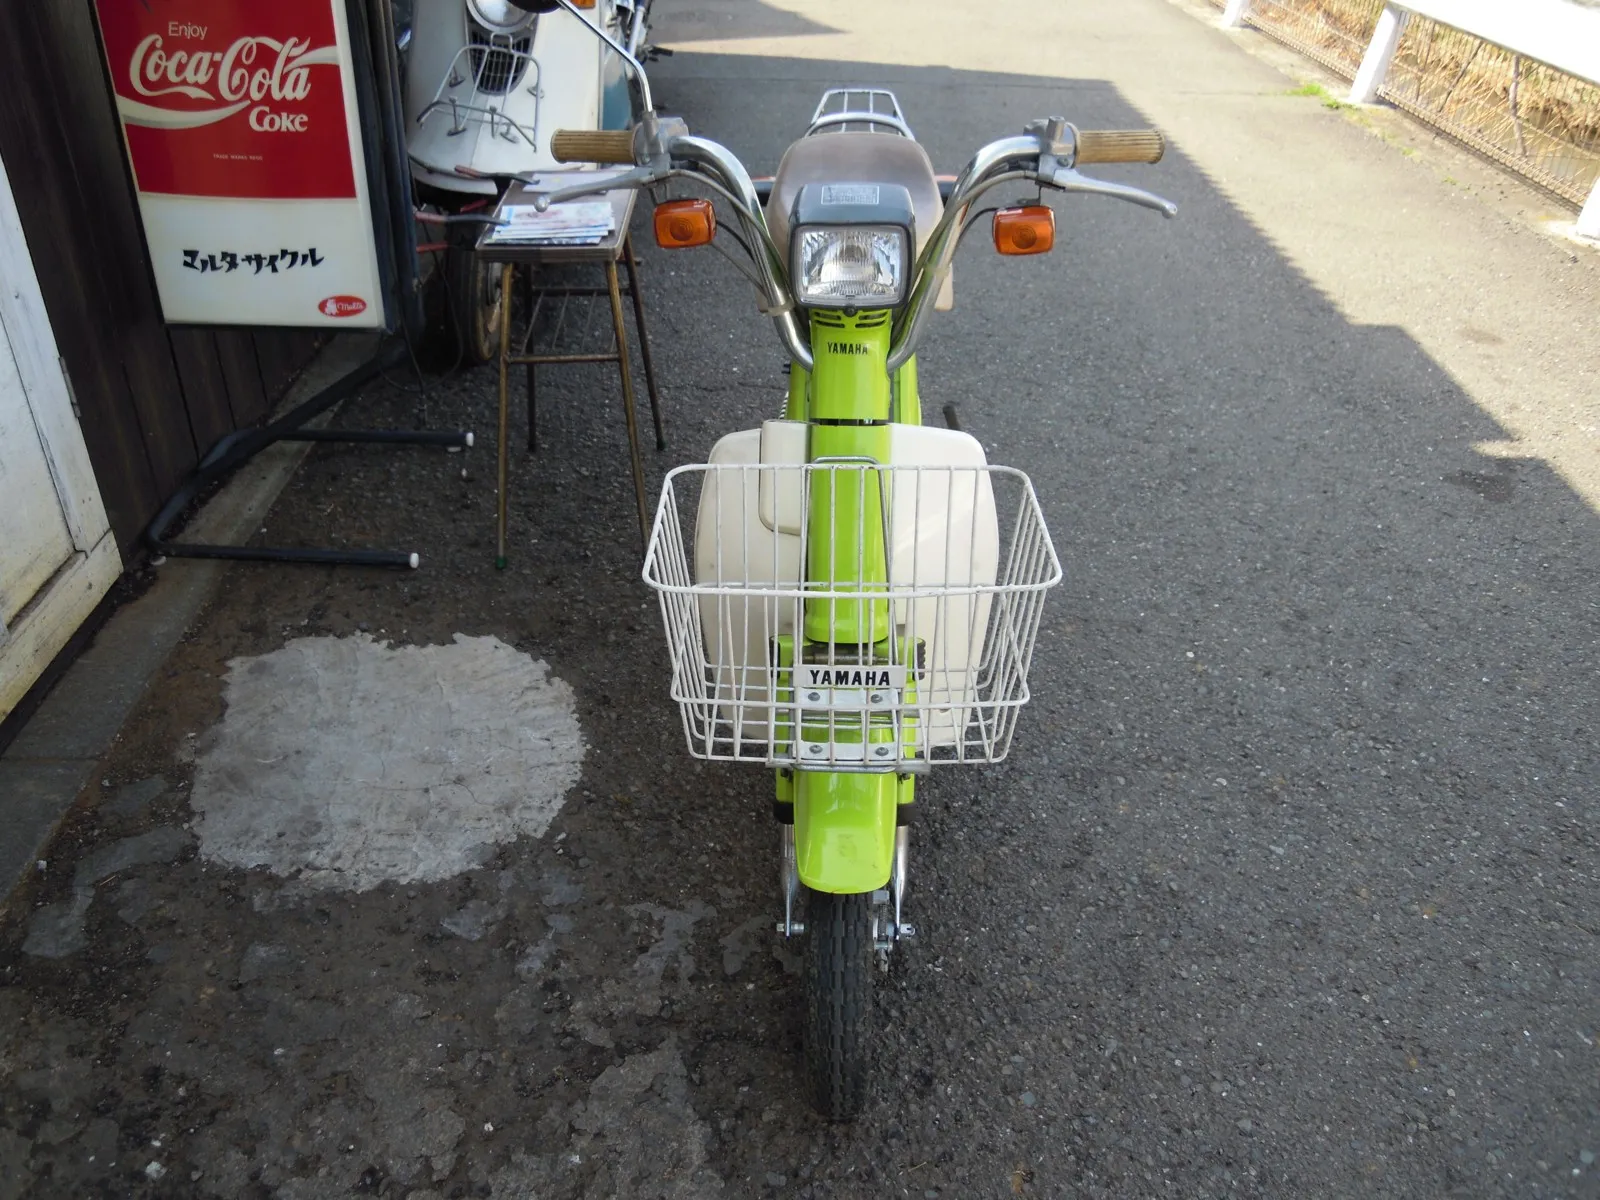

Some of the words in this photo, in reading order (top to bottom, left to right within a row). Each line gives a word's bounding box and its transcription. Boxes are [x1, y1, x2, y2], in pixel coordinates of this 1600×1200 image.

[168, 21, 208, 40] Enjoy
[129, 33, 311, 101] Coca-Cola
[249, 106, 309, 132] Coke
[183, 248, 325, 275] マルタサイクル
[827, 342, 868, 355] YAMAHA
[809, 670, 890, 686] YAMAHA
